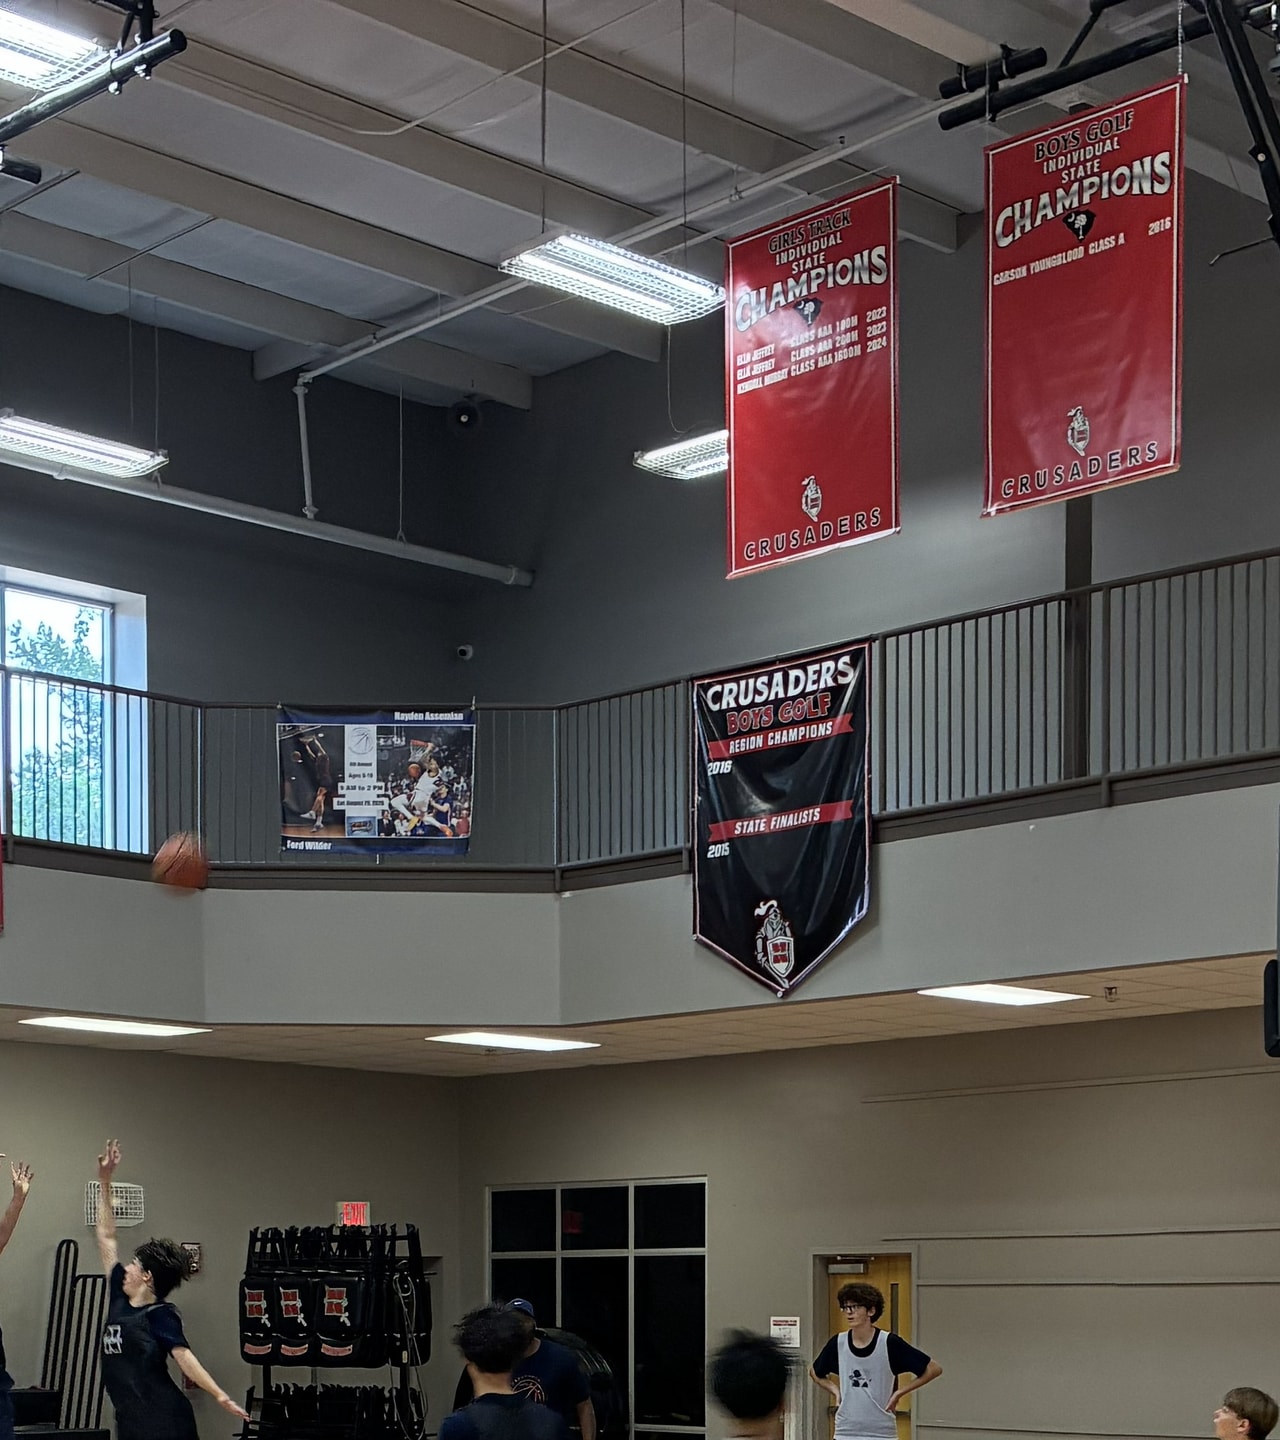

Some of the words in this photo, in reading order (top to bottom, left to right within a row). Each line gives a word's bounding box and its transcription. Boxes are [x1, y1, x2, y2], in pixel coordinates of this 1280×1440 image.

[1034, 129, 1081, 162] BOYS
[1086, 109, 1134, 141] GOLF
[1043, 137, 1120, 174] INDIVIDUAL
[1061, 158, 1101, 184] STATE
[995, 151, 1171, 248] CHAMPIONS
[768, 226, 805, 253] GIRLS
[807, 208, 852, 238] TRACK
[775, 232, 843, 265] INDIVIDUAL
[791, 252, 825, 274] STATE
[1030, 246, 1085, 275] YOUNGBLOOD
[1088, 237, 1116, 255] CLASS
[1118, 232, 1125, 245] A
[735, 245, 888, 332] CHAMPIONS
[791, 330, 815, 347] CLASS
[866, 306, 887, 322] 2023
[791, 345, 815, 362] CLASS
[866, 321, 887, 337] 2023
[791, 360, 815, 377] CLASS
[866, 336, 887, 353] 2024
[1002, 441, 1158, 498] CRUSADERS
[744, 507, 881, 560] CRUSADERS
[707, 655, 854, 712] CRUSADERS
[726, 705, 774, 735] BOYS
[778, 692, 831, 723] GOLF
[729, 735, 763, 754] REGION
[767, 722, 833, 746] CHAMPIONS
[734, 819, 766, 835] STATE
[770, 808, 820, 830] FINALISTS
[707, 843, 730, 859] 2015
[343, 1203, 367, 1225] EXIT
